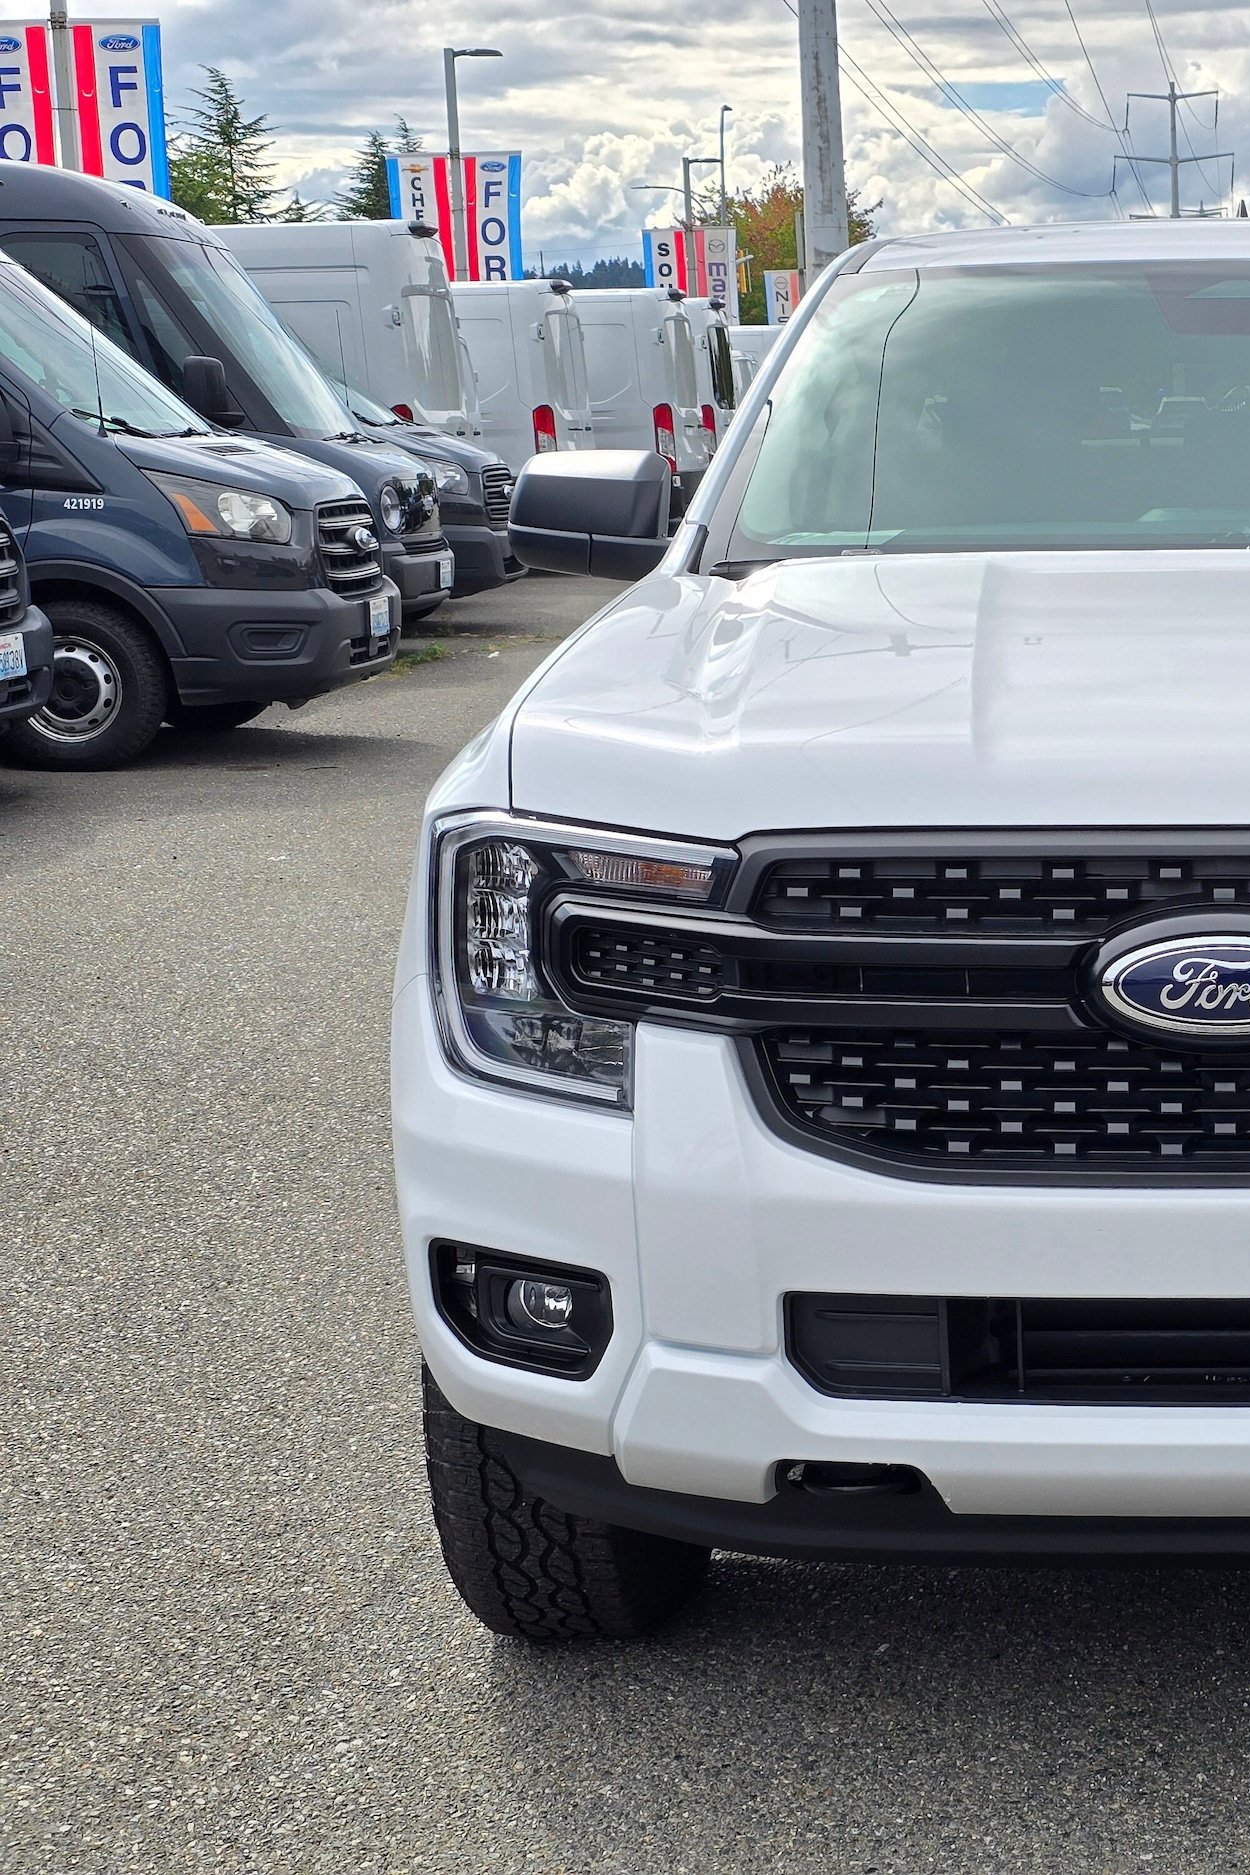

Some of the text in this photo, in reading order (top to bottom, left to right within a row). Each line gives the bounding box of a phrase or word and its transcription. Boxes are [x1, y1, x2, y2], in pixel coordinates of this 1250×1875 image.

[106, 37, 134, 49] Ford
[109, 66, 147, 190] FO
[657, 242, 673, 288] SO
[63, 498, 105, 510] 421919
